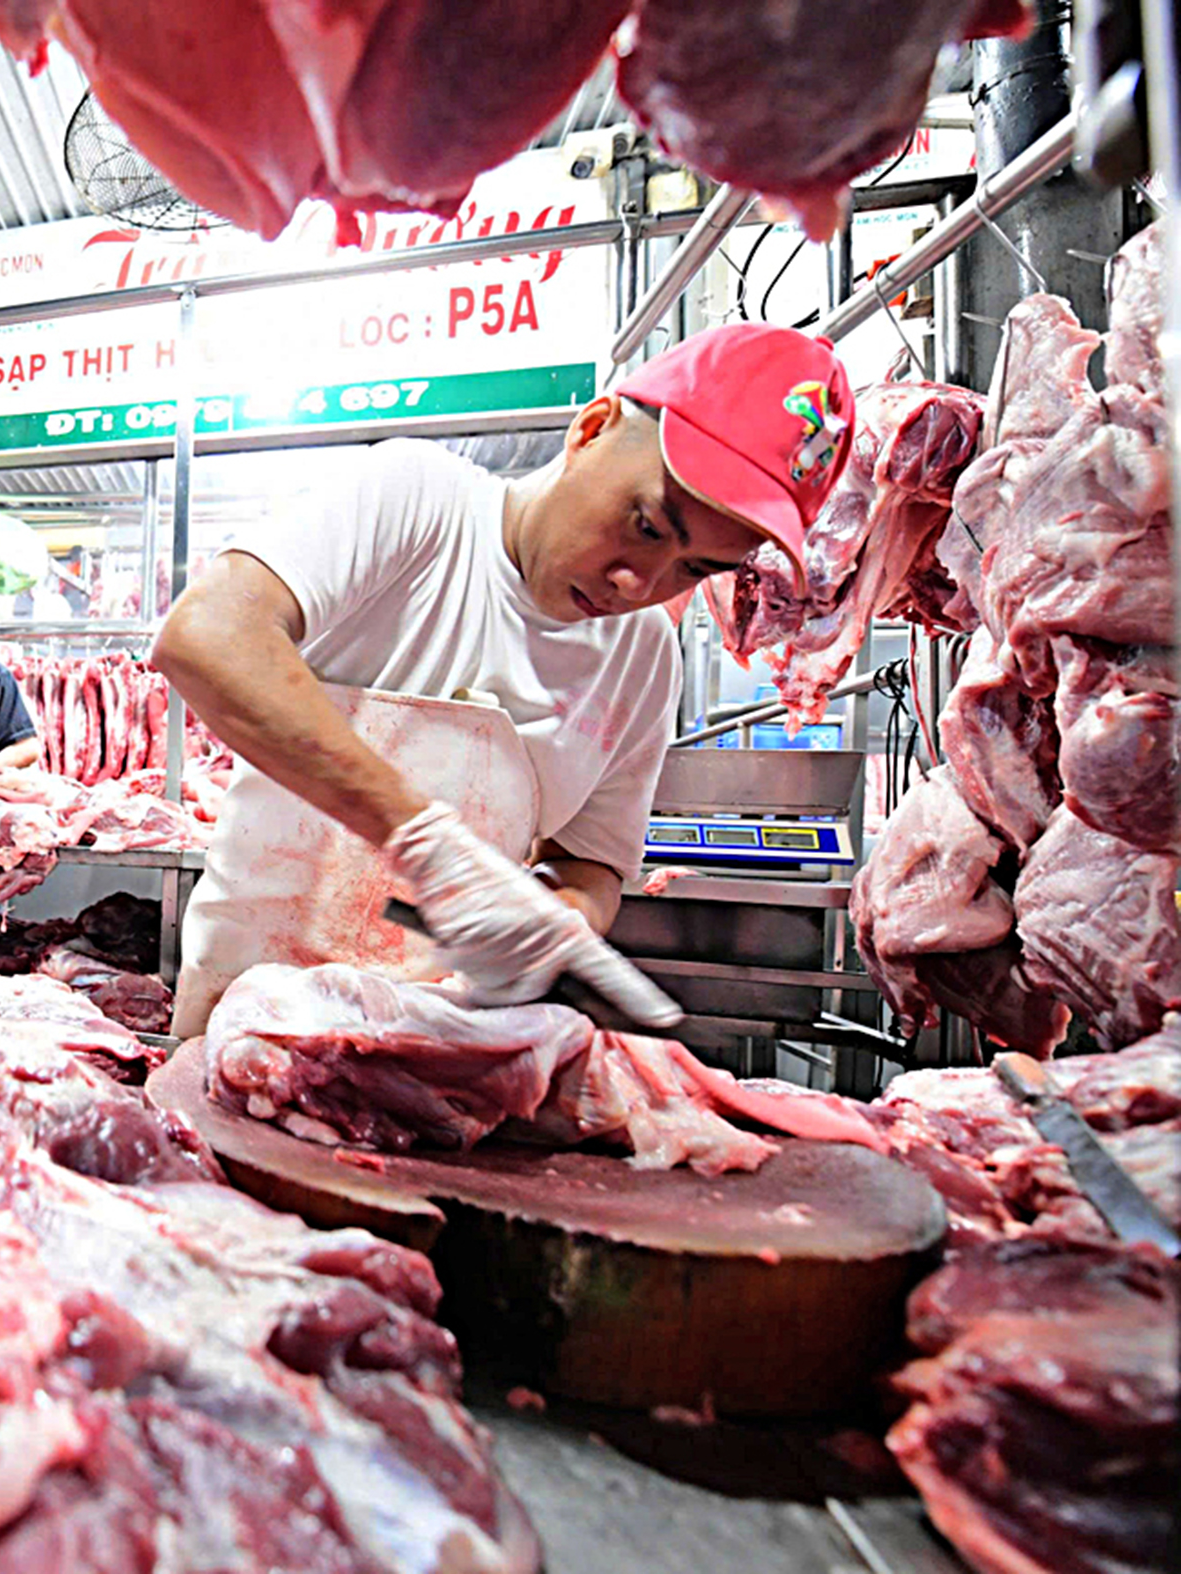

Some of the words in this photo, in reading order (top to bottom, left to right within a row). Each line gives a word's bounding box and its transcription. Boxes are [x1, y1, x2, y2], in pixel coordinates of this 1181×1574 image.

[61, 343, 135, 383] THỊT
[446, 278, 542, 340] P5A
[339, 381, 429, 412] 697
